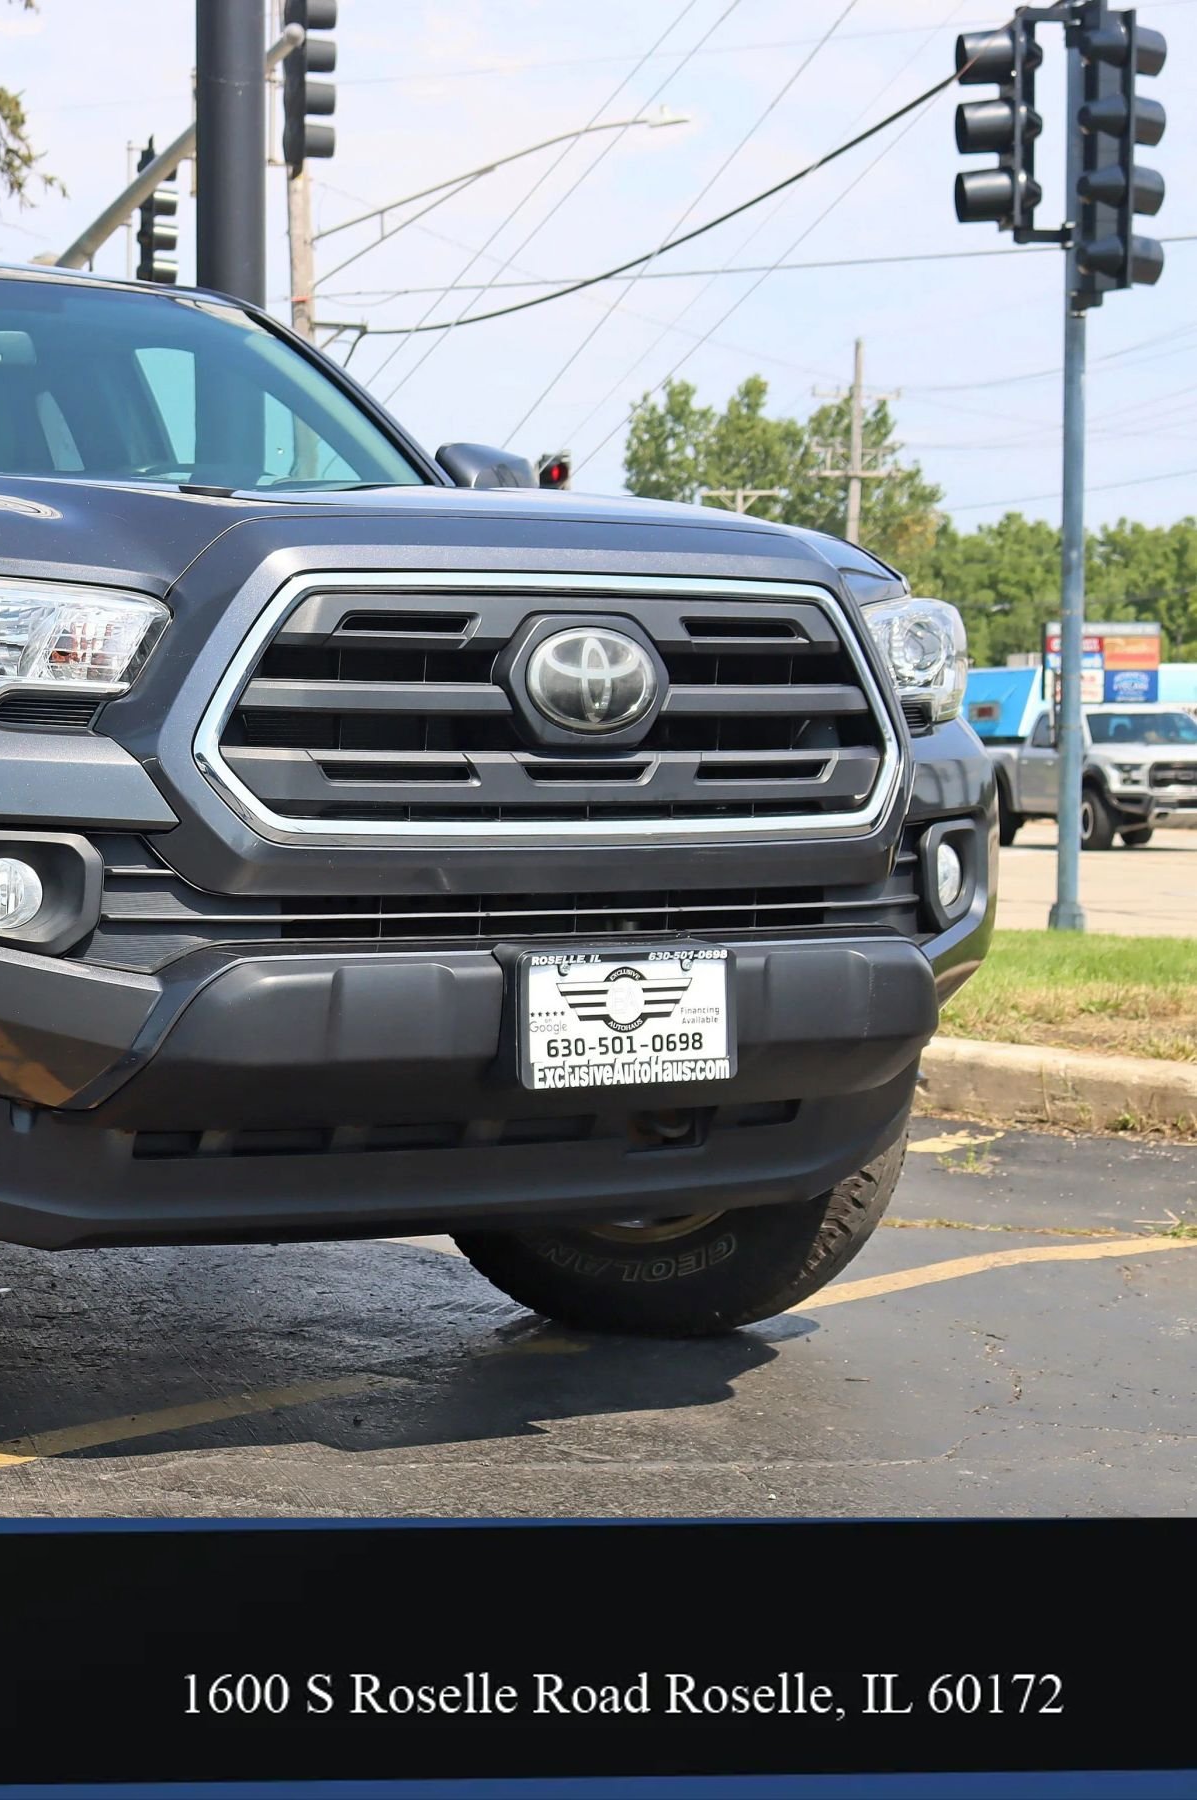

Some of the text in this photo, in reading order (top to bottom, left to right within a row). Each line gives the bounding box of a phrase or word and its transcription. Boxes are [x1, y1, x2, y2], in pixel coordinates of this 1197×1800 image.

[589, 954, 602, 963] IL
[648, 949, 728, 960] 630-501-0698
[609, 968, 641, 981] EXCLUSIVE
[529, 1021, 568, 1035] Google
[607, 1017, 644, 1032] AUTOHAUS
[546, 1031, 703, 1058] 630-501-0698
